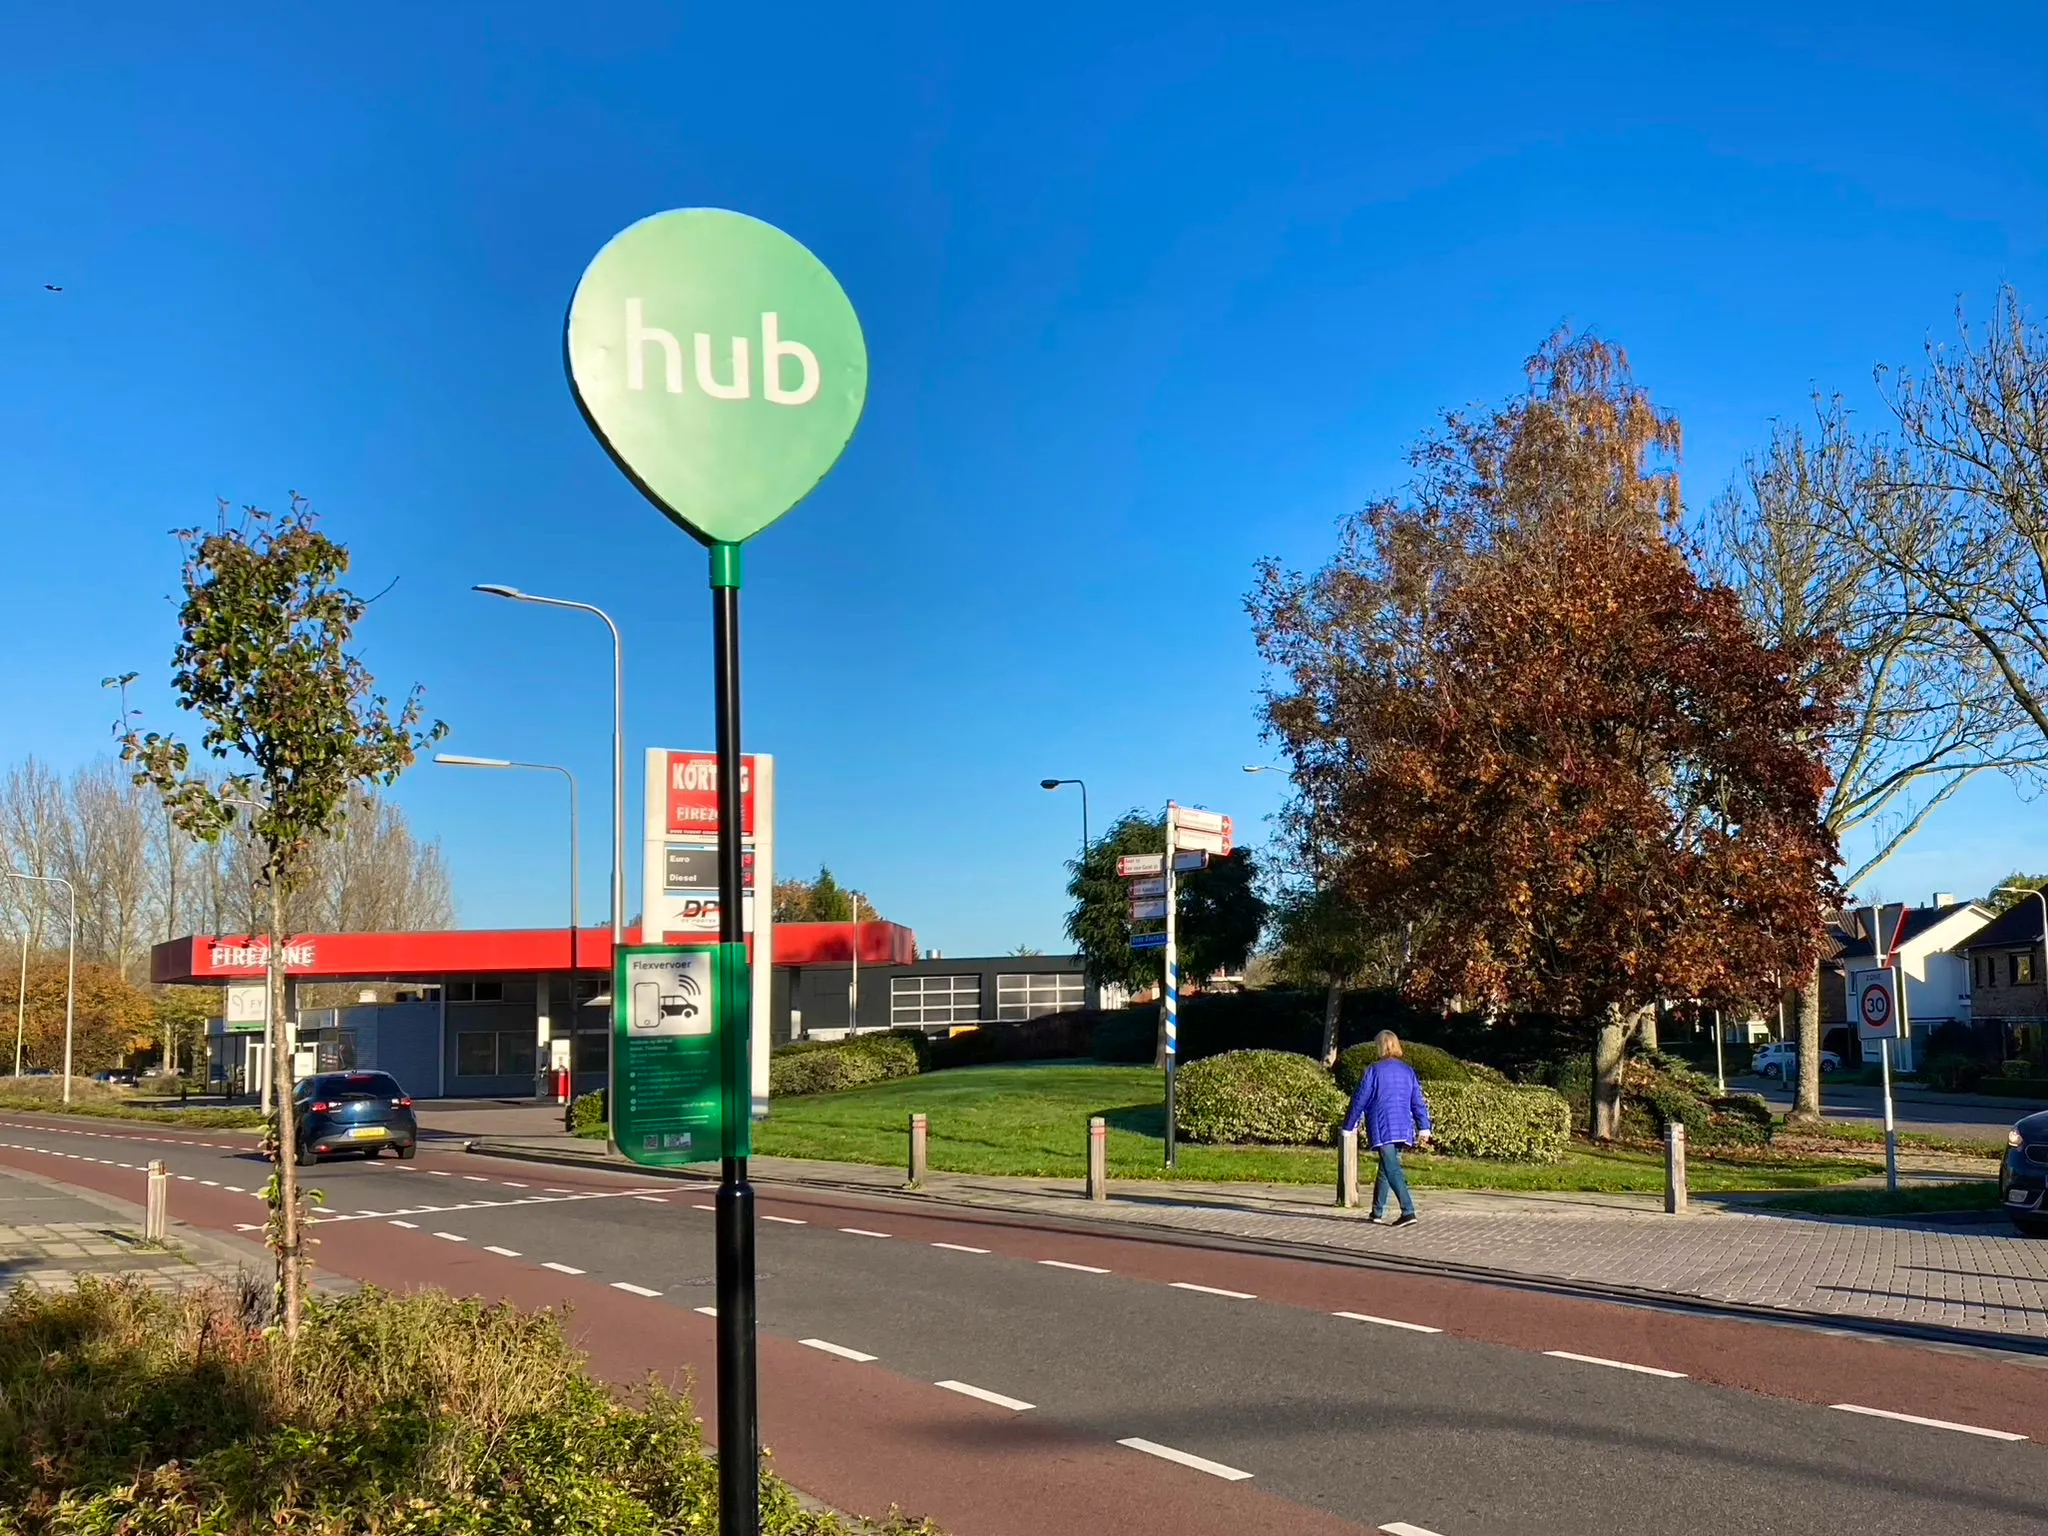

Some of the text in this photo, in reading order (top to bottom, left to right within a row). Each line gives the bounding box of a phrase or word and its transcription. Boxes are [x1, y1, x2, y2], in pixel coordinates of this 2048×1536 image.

[625, 297, 821, 406] hub
[672, 762, 749, 793] KORTG
[676, 806, 718, 821] FIREZ
[669, 855, 690, 863] Euro
[669, 874, 697, 882] Diesel
[633, 960, 692, 970] Flexvervoer
[1867, 996, 1885, 1013] 30
